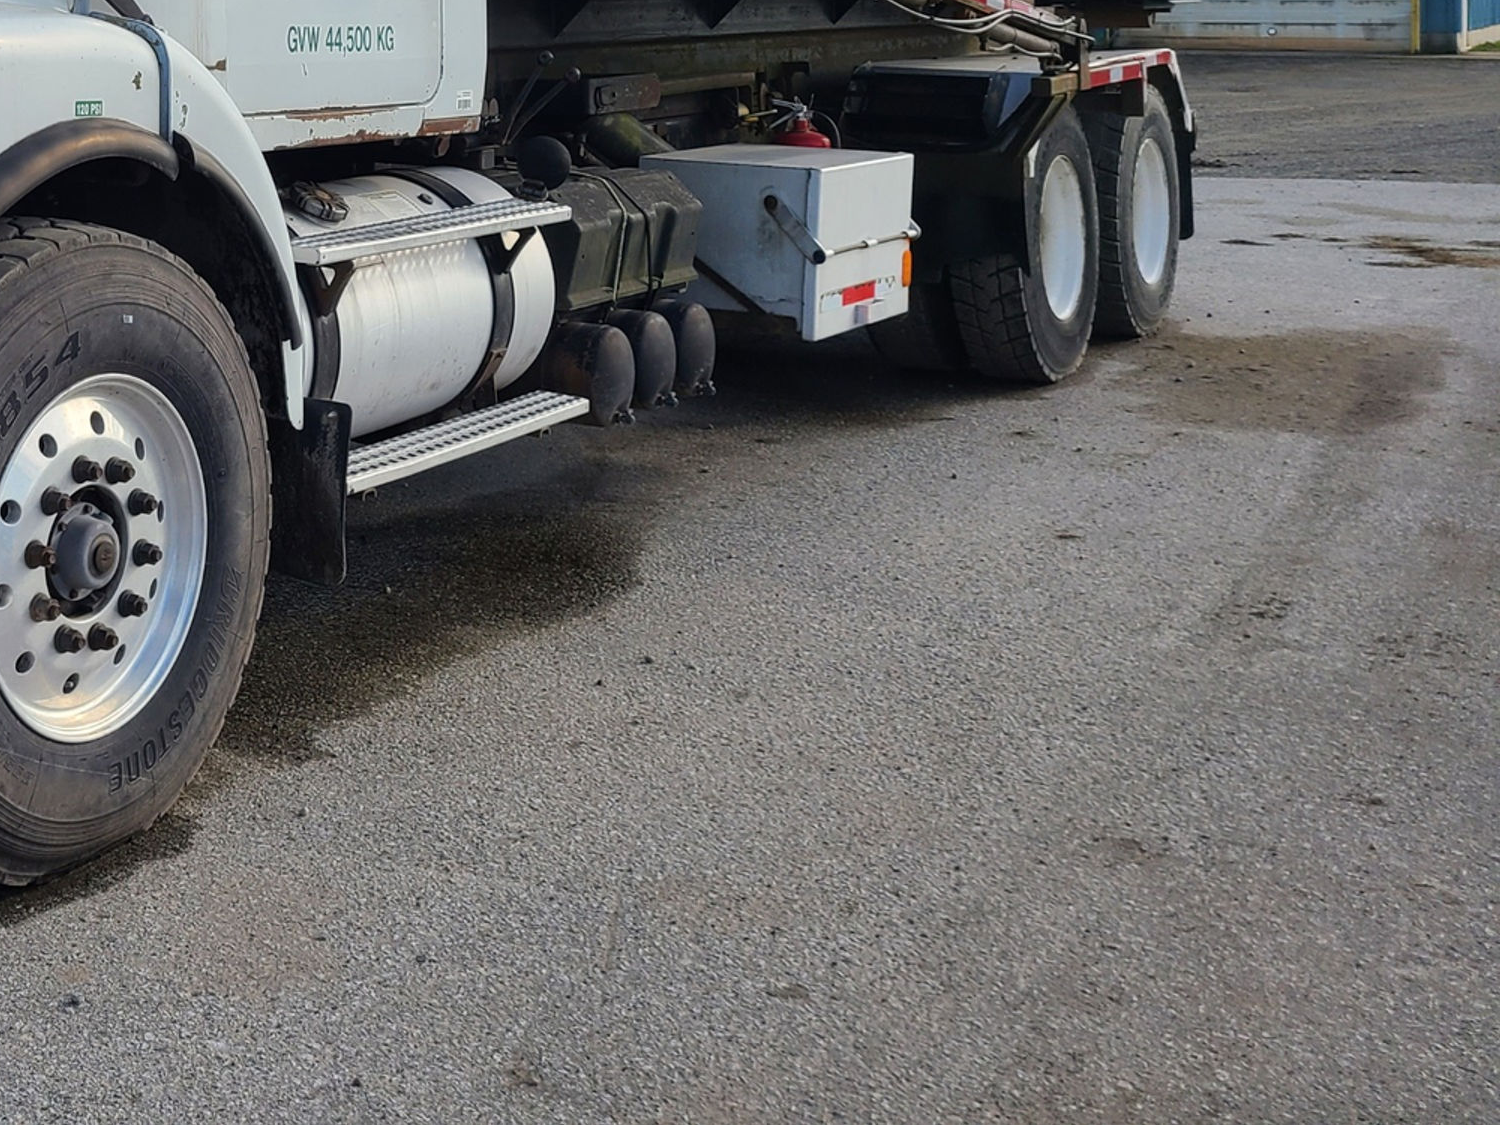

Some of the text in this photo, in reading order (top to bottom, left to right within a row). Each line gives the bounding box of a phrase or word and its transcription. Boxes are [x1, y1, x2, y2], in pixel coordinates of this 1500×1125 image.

[287, 25, 395, 57] GVW 44,500 KG
[107, 565, 245, 796] BRIDGESTONE
